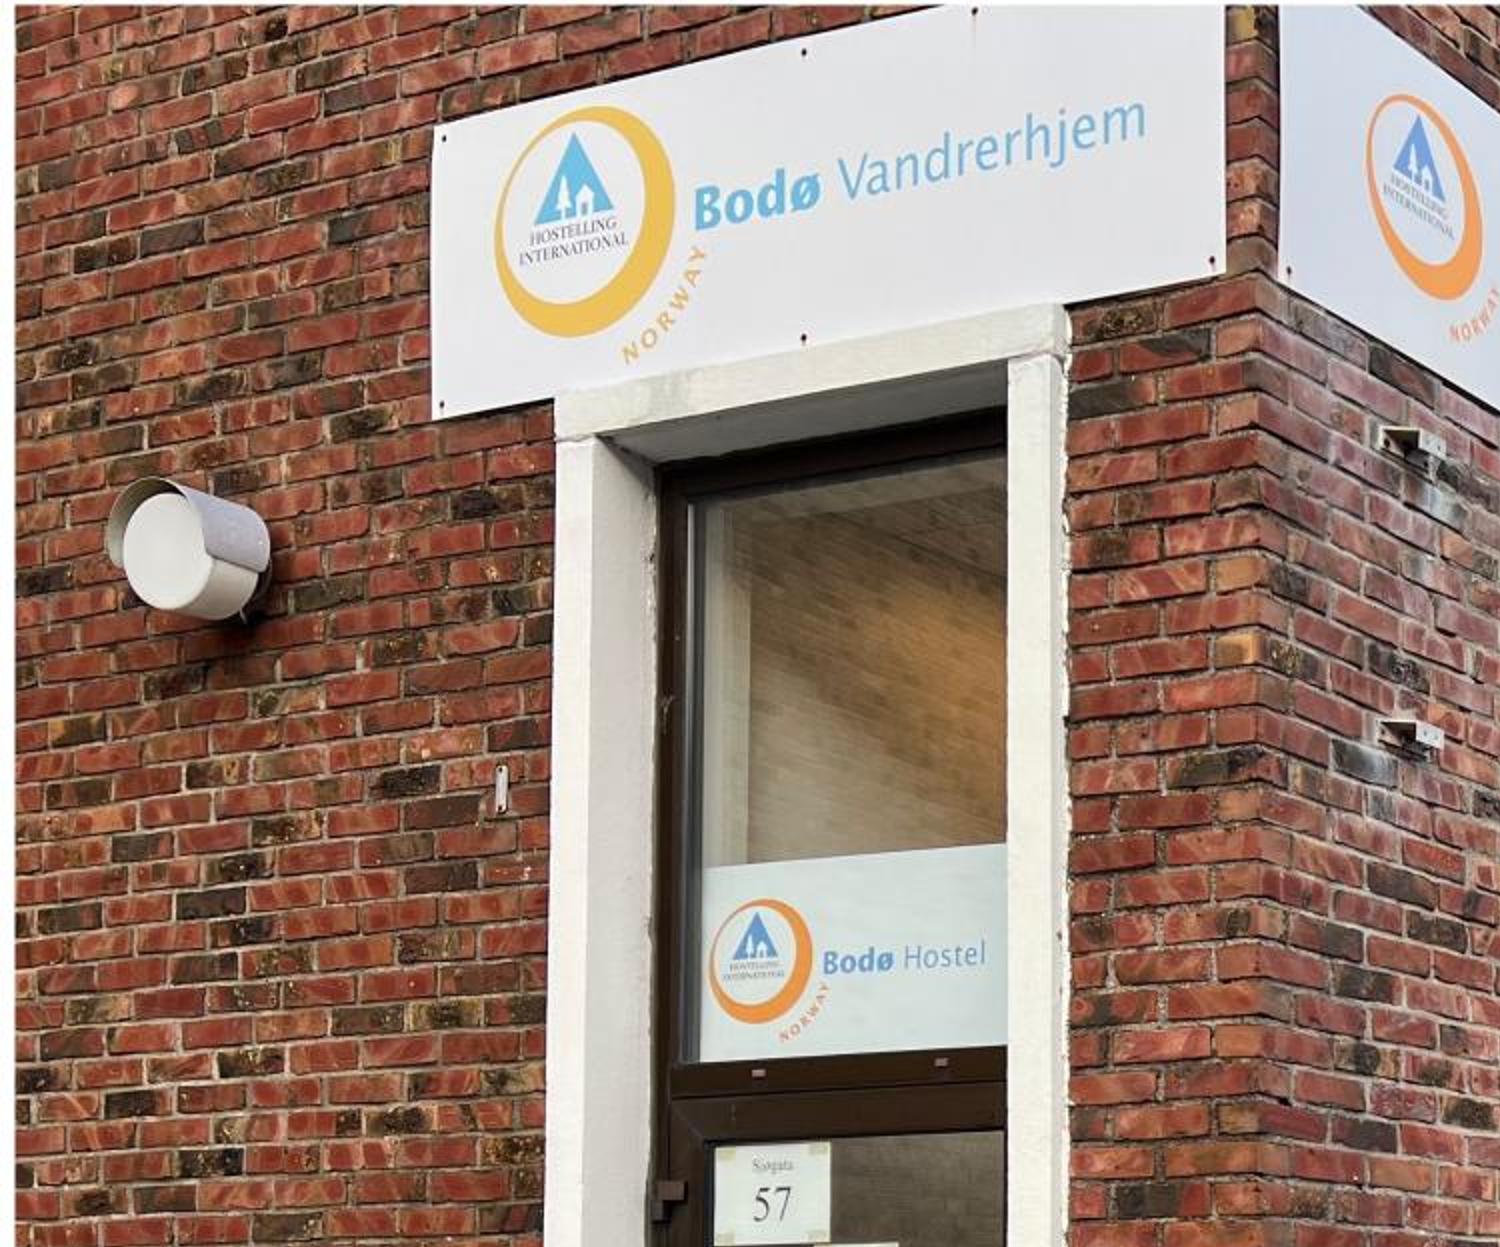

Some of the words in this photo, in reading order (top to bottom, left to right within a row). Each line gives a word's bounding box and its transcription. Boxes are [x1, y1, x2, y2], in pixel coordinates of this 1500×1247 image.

[694, 165, 820, 232] Bodø
[838, 100, 1147, 201] Vandrerhjem
[518, 231, 630, 267] INTERNATIONAL
[529, 216, 618, 247] HOSTELLING
[621, 245, 706, 364] NORWAY
[1449, 287, 1500, 342] NORWAY
[822, 946, 894, 975] Bodø
[904, 939, 987, 969] Hostel
[779, 983, 830, 1042] NORWAY
[753, 1185, 792, 1223] 57
